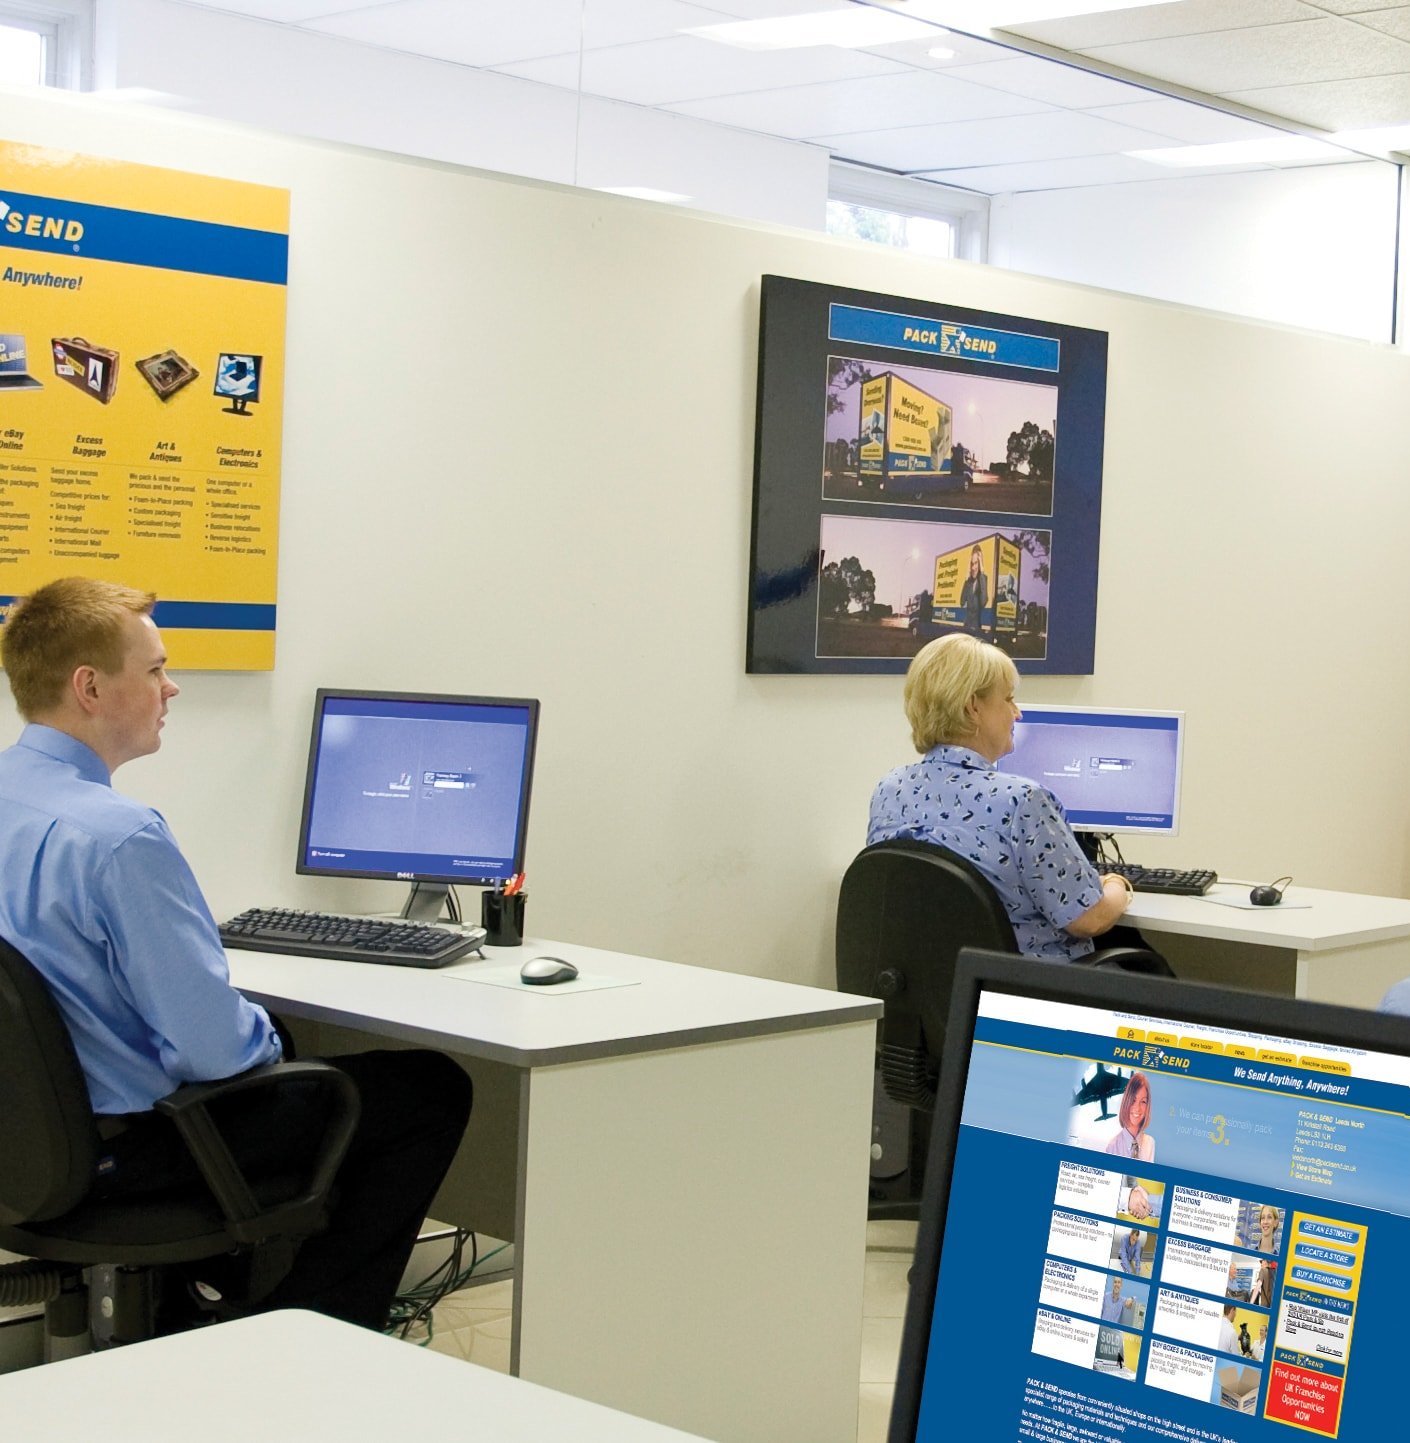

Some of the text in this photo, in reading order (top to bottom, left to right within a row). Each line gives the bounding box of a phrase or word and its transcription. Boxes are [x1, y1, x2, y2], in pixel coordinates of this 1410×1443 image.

[5, 212, 84, 242] SEND
[2, 267, 83, 291] Anywhere!
[903, 327, 997, 354] PACK SEND
[902, 396, 925, 415] Moving?
[76, 434, 104, 445] Excess
[156, 441, 169, 451] Art
[72, 446, 107, 458] Baggage
[149, 452, 183, 464] Antiques
[216, 446, 255, 458] Computers
[219, 457, 259, 469] Electronics
[1113, 1047, 1191, 1068] PACK SEND
[1234, 1066, 1350, 1096] We Send Anything, Anywhere!
[1303, 1223, 1315, 1231] GET
[1301, 1247, 1323, 1258] LOCATE
[1329, 1253, 1349, 1263] STORE
[1275, 1367, 1339, 1392] Find out more about
[1284, 1382, 1326, 1401] UK Franchise
[1281, 1394, 1325, 1414] Opportunities
[1294, 1410, 1311, 1421] NOW
